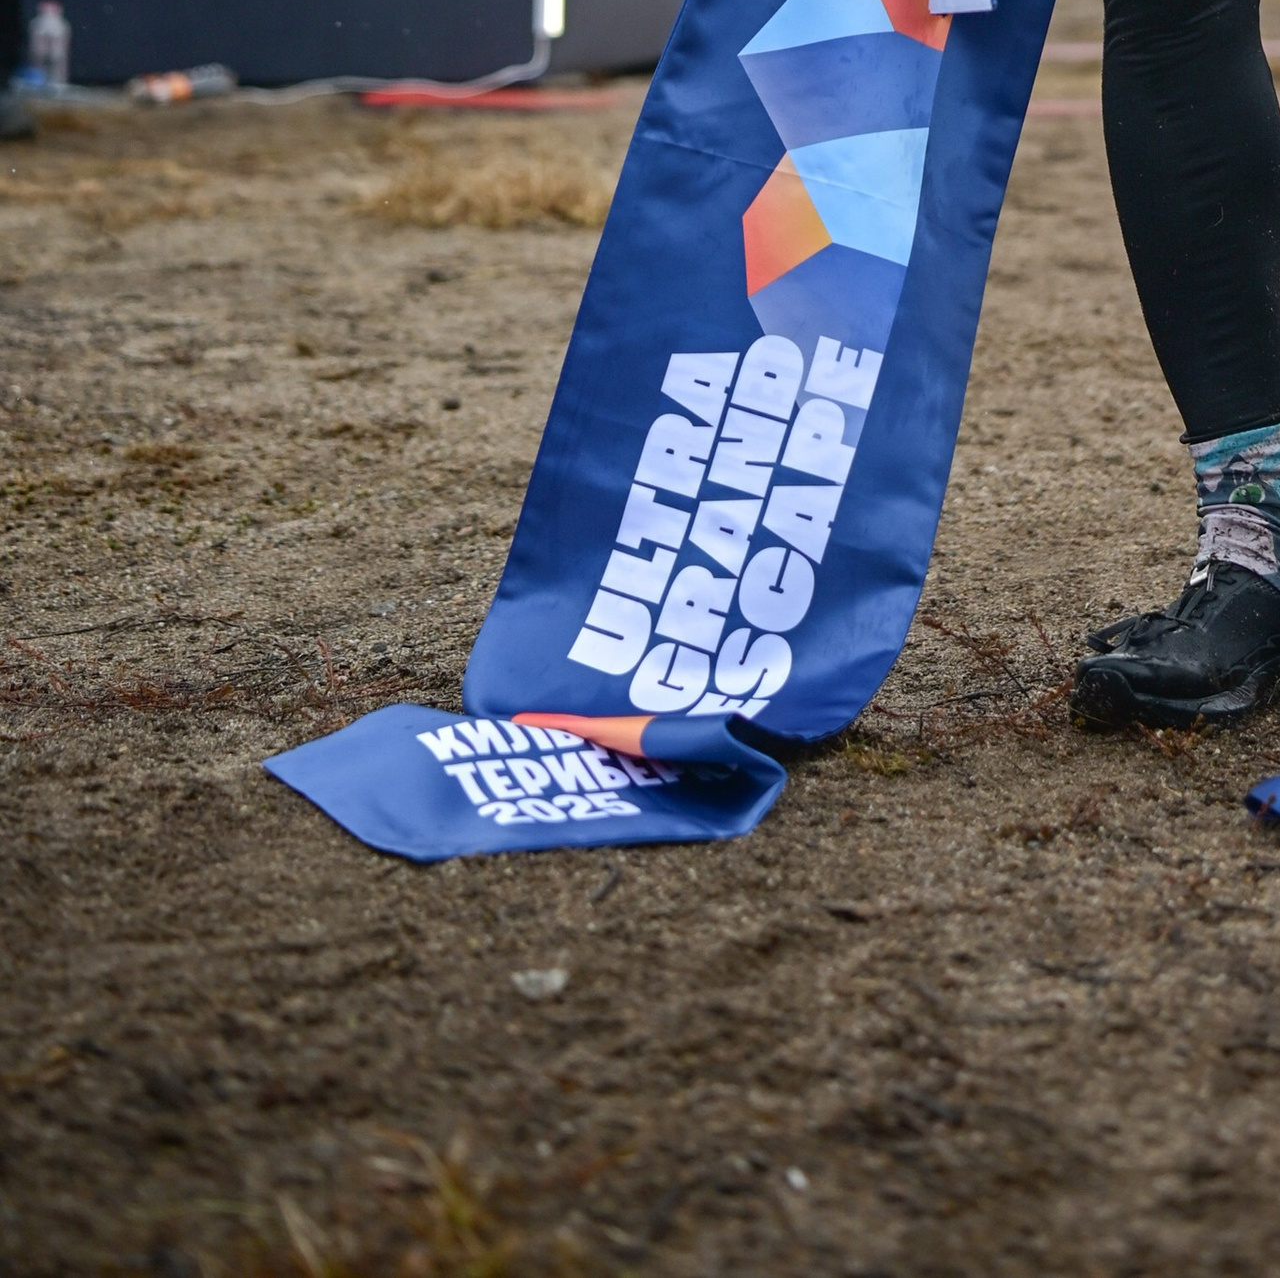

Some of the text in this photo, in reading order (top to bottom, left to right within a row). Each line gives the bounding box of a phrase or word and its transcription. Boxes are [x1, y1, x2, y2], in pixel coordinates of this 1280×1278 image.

[567, 350, 740, 676] ULTRA
[629, 334, 805, 713] GRAND
[477, 790, 643, 826] 2025
